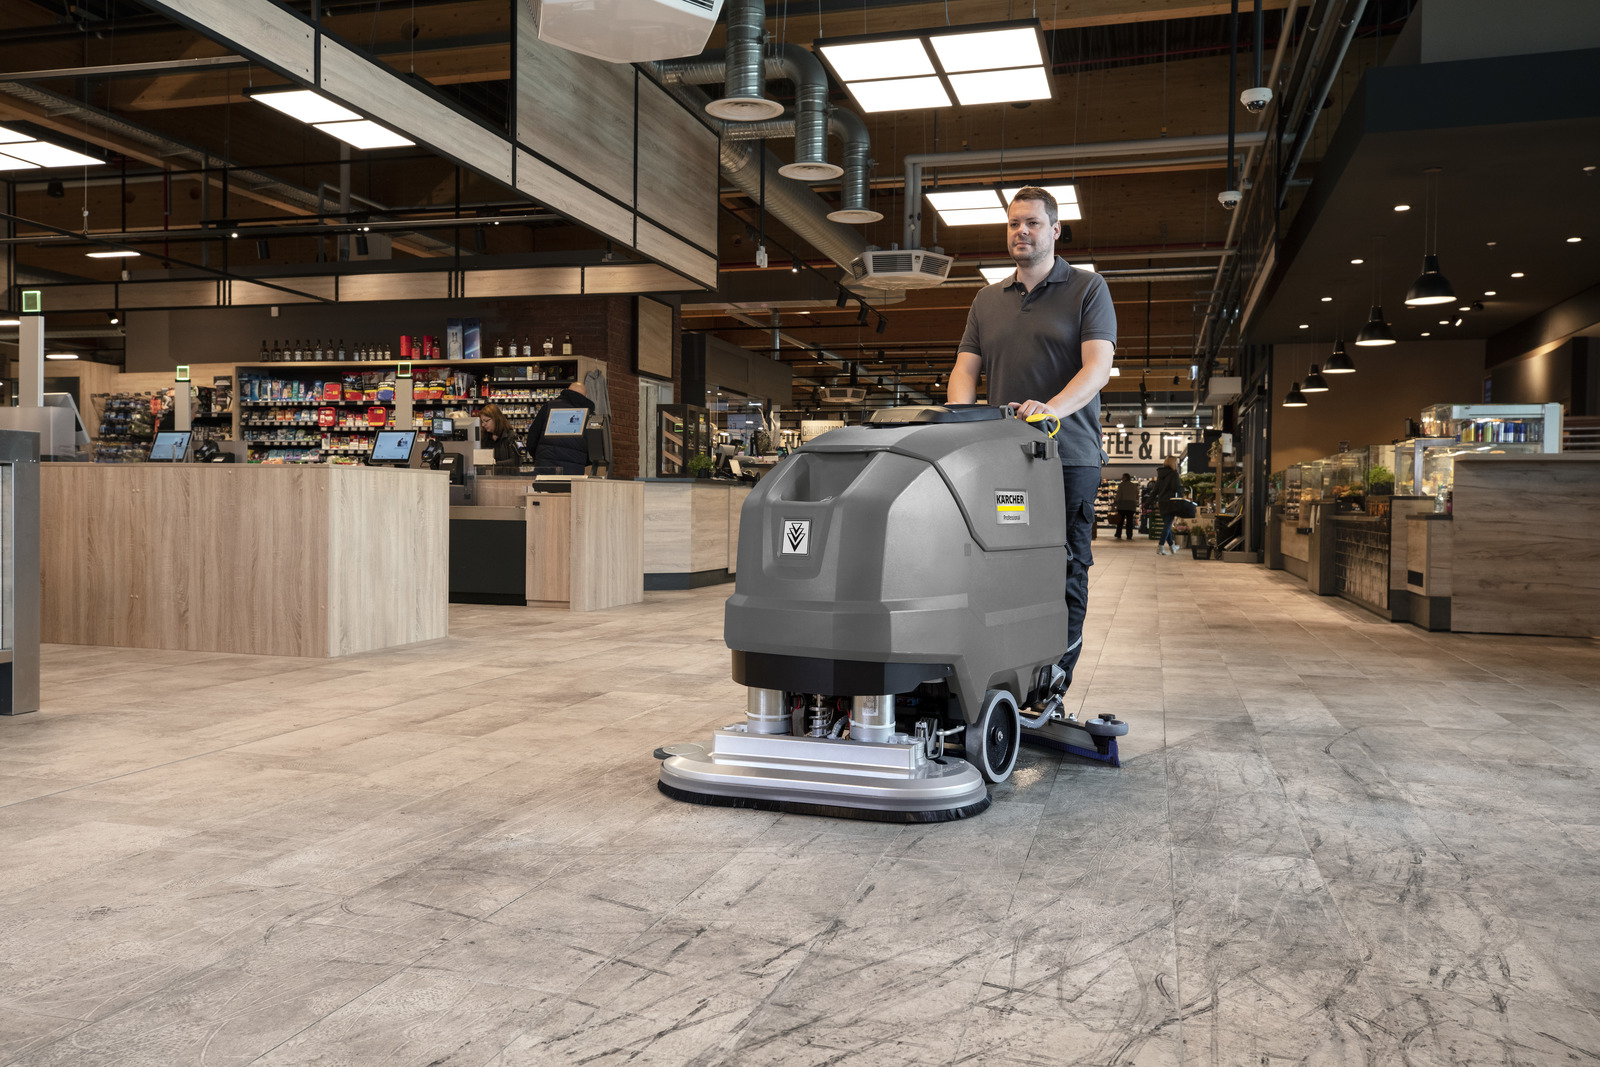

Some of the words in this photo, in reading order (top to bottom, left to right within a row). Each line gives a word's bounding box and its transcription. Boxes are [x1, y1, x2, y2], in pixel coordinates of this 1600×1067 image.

[1102, 432, 1133, 454] FEE
[1138, 431, 1152, 460] &
[996, 494, 1024, 504] KÄRCHER
